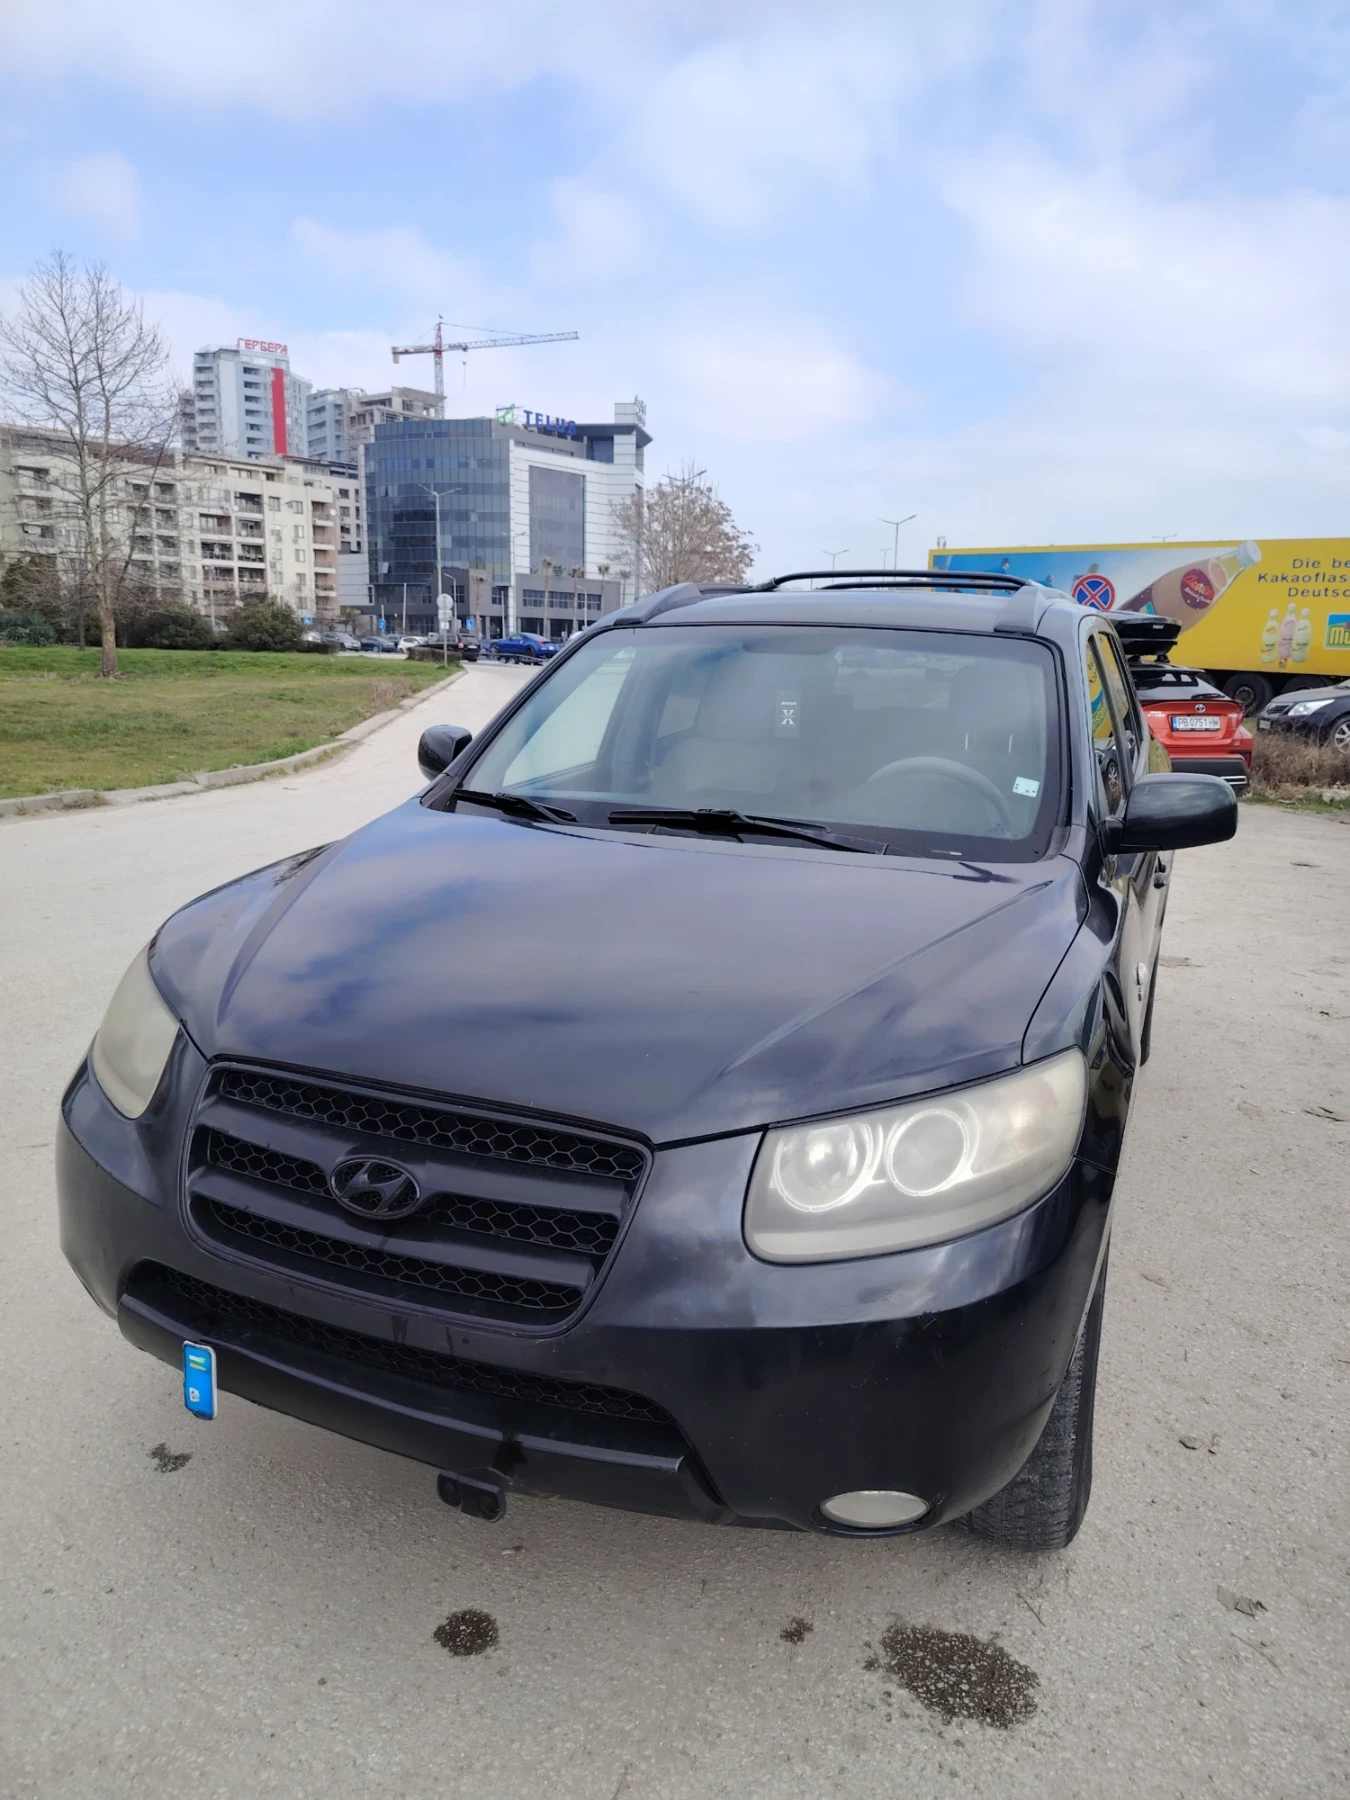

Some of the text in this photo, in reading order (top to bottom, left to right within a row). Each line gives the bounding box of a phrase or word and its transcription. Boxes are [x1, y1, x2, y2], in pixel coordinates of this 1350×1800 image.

[237, 337, 288, 356] ГЕРБЕРА
[523, 409, 577, 436] TELUS
[1292, 558, 1350, 569] Die be
[1257, 572, 1348, 583] Kakaoflas
[1287, 587, 1350, 597] Deutsc
[1190, 717, 1208, 727] 0751
